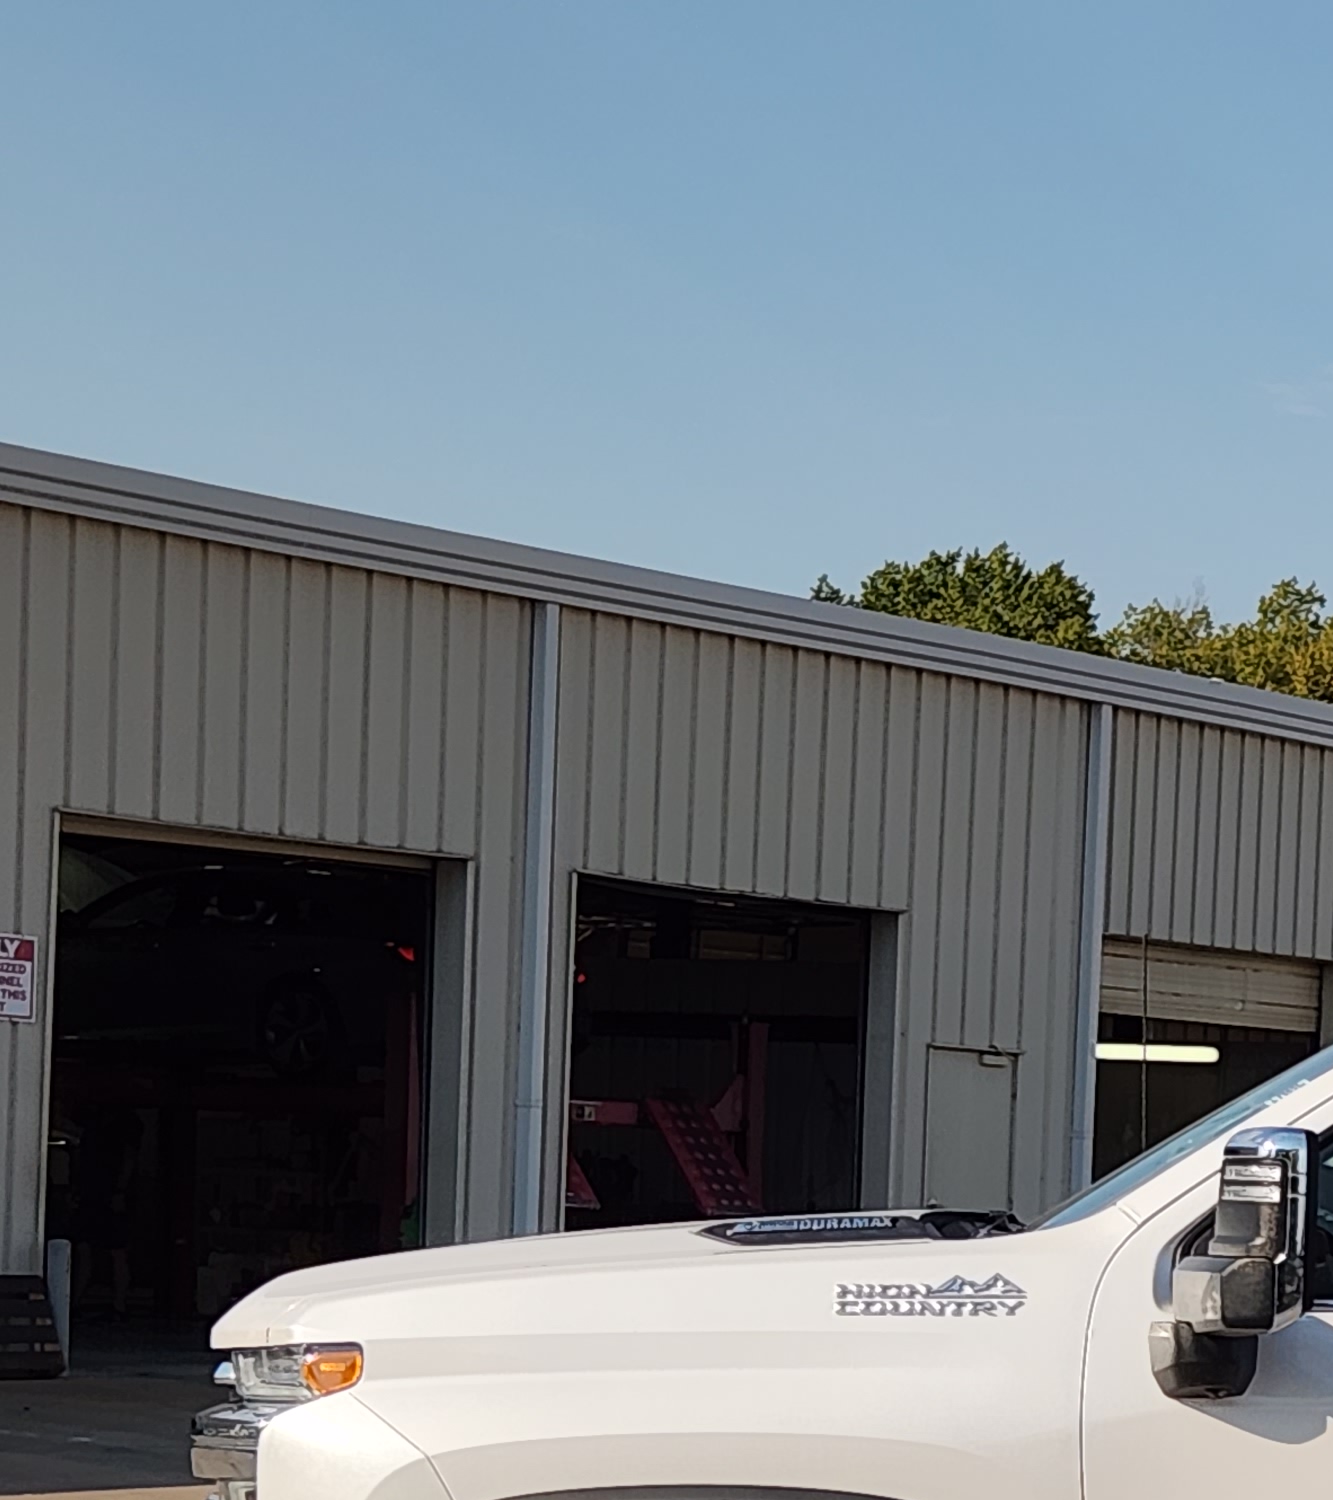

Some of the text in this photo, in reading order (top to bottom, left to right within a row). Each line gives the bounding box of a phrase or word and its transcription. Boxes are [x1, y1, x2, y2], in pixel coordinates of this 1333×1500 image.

[799, 1216, 893, 1230] DURAMAX
[834, 1283, 933, 1299] HIGH
[833, 1300, 1026, 1317] COUNTRY
